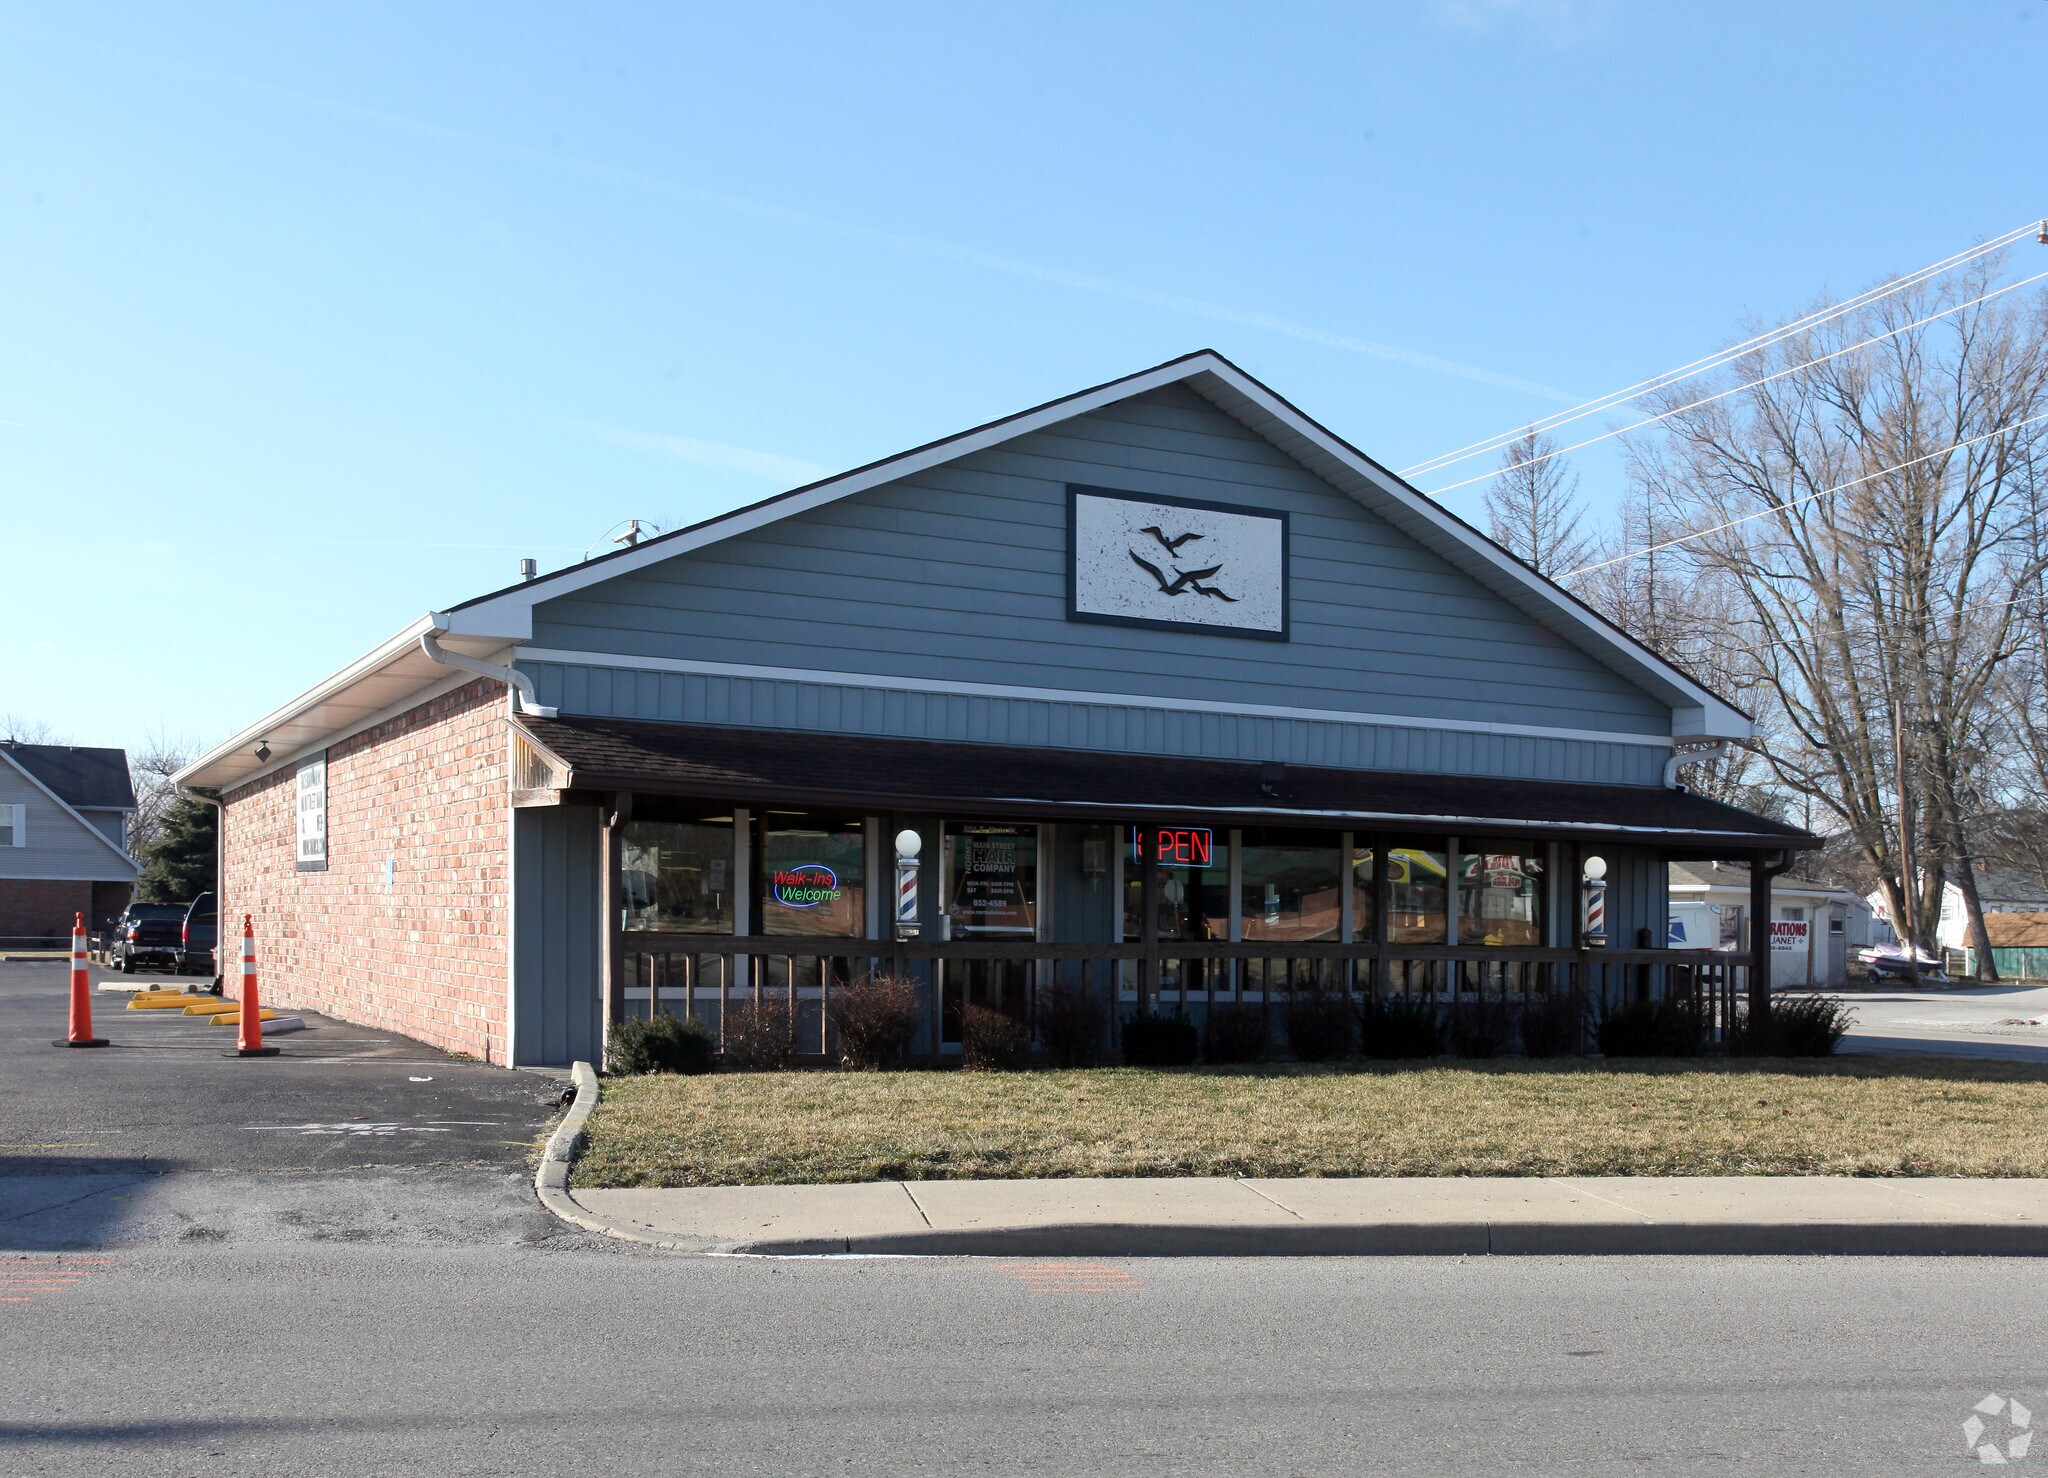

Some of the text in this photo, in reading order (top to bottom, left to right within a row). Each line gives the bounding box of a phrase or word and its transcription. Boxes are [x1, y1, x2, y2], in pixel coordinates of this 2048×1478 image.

[973, 848, 1016, 865] HAIR
[973, 864, 1016, 873] COMPANY
[773, 871, 834, 885] Walk-Ins
[782, 886, 842, 901] Welcome
[1770, 922, 1807, 936] RATIONS
